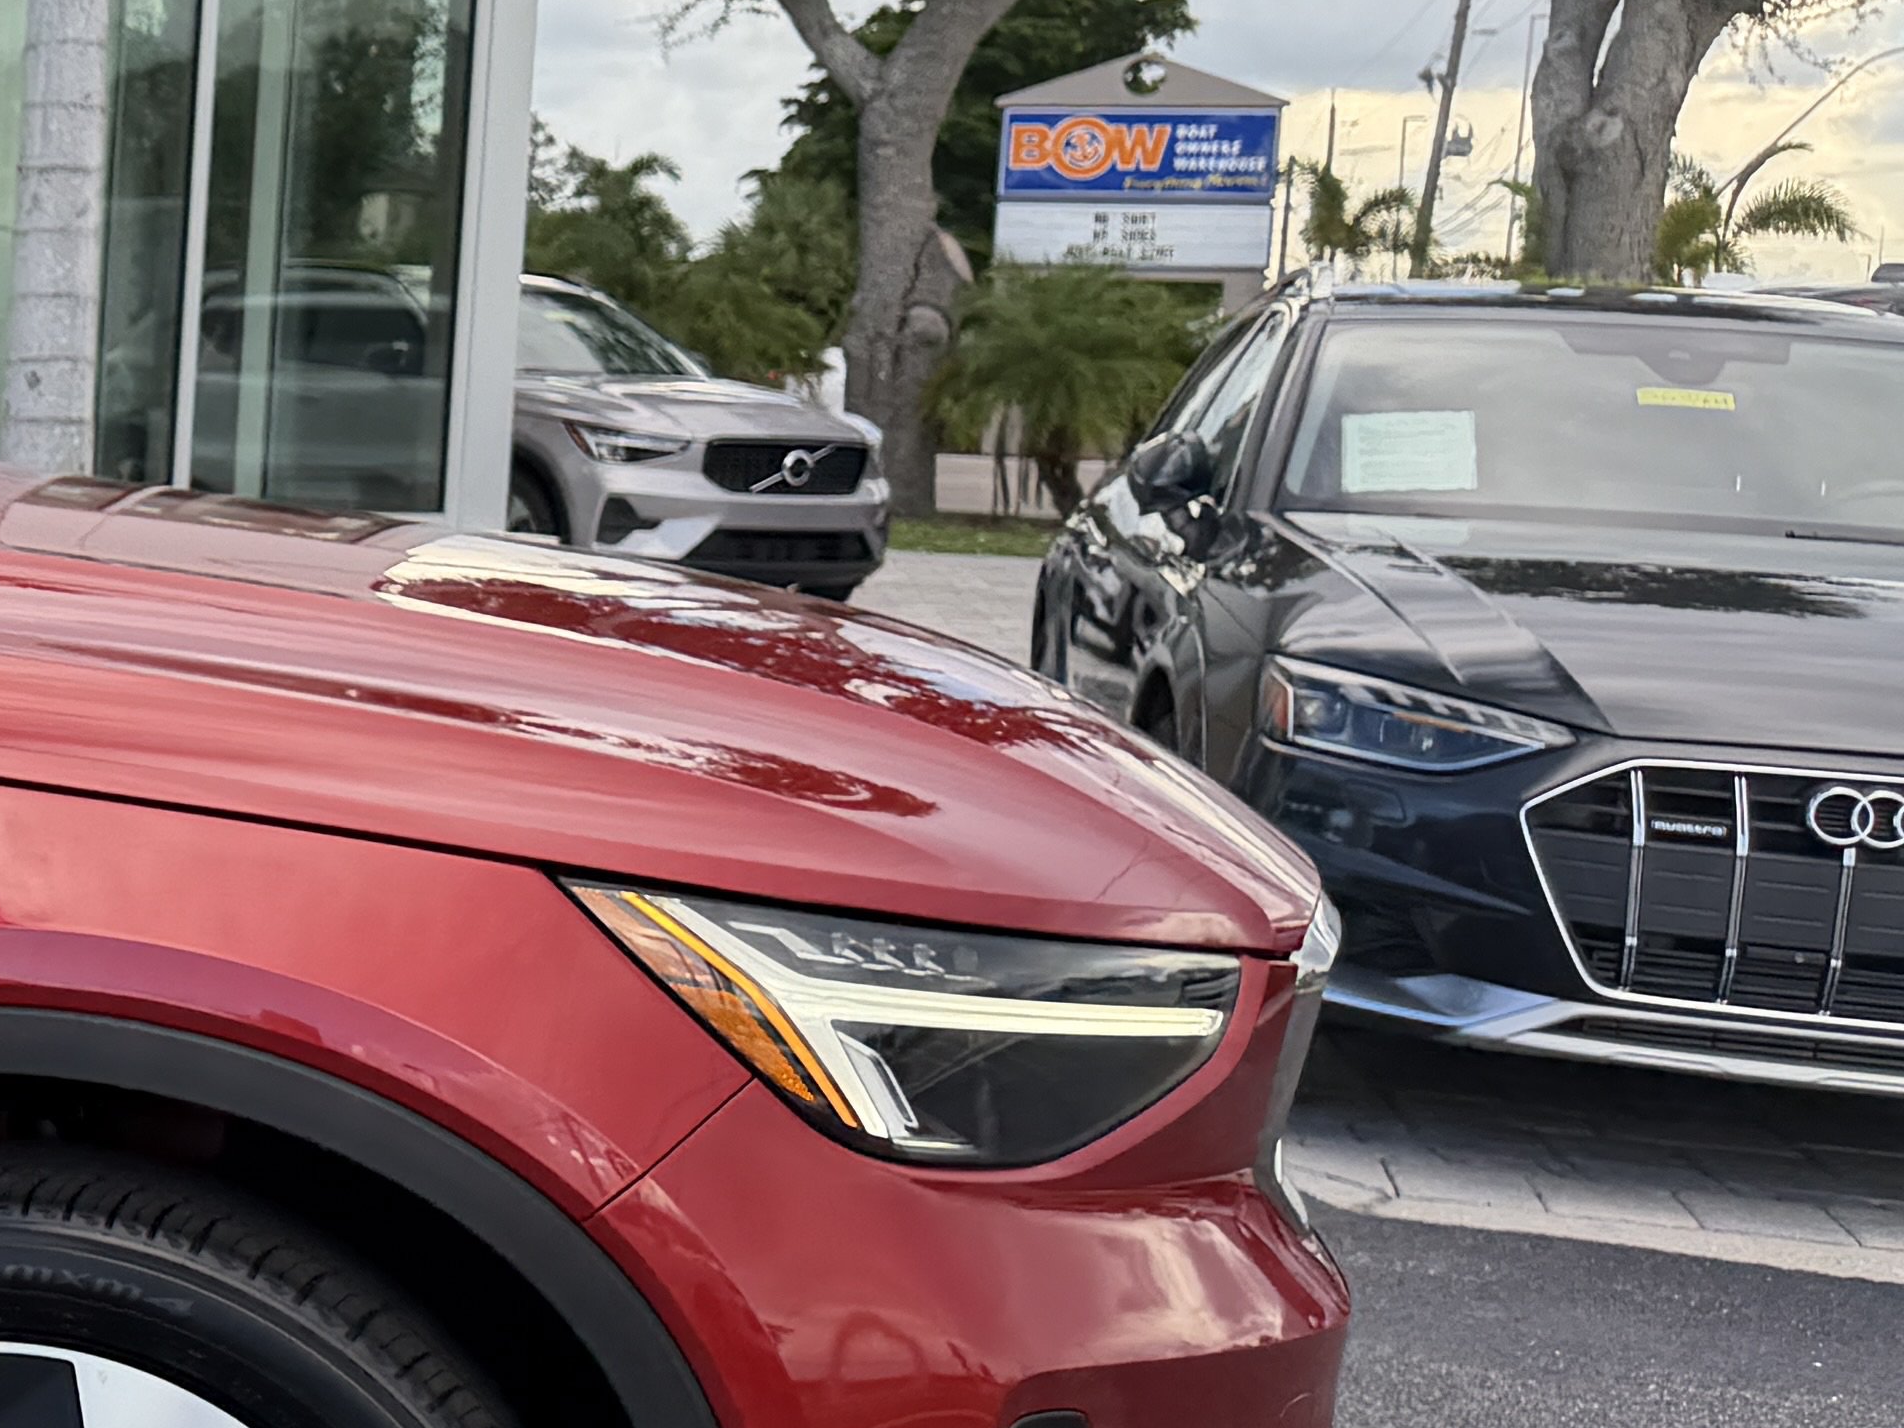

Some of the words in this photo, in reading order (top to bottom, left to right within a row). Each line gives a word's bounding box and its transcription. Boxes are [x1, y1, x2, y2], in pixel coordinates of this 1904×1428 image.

[1175, 124, 1219, 139] BOAT
[1010, 117, 1171, 179] BOW
[1174, 140, 1243, 156] OWNERS
[1173, 156, 1267, 172] WAREHOUSE
[1653, 820, 1724, 837] quattro
